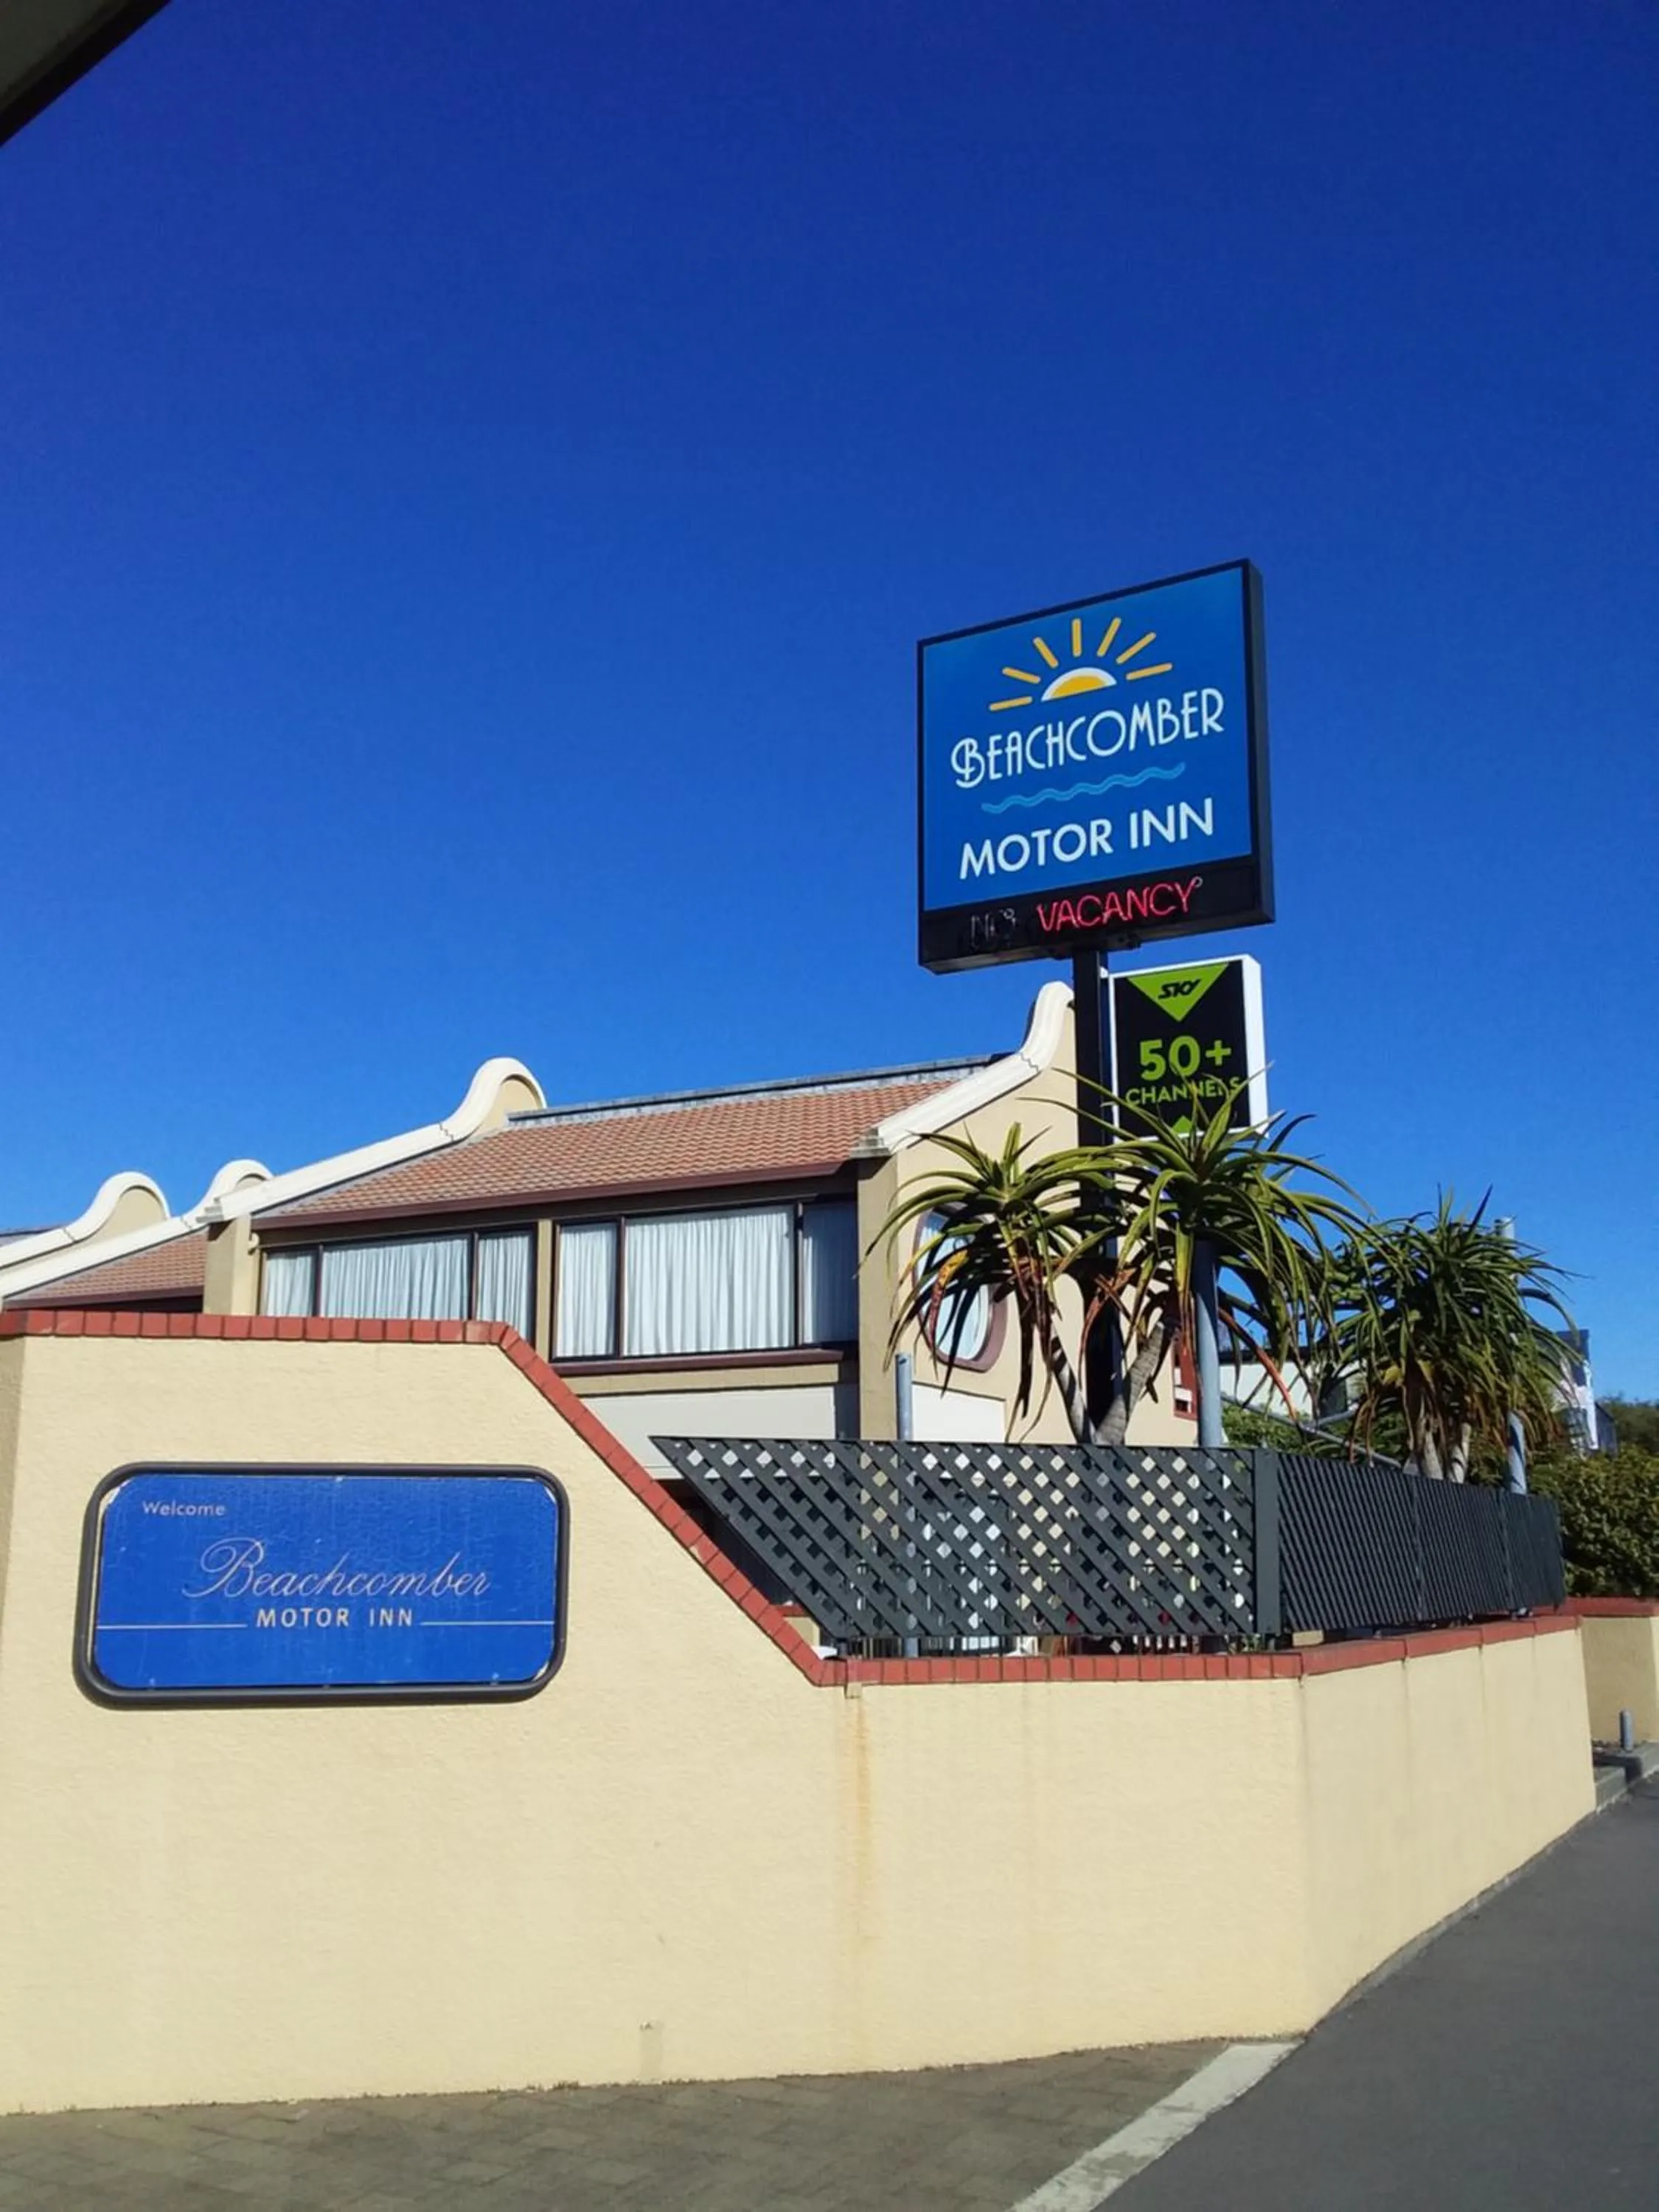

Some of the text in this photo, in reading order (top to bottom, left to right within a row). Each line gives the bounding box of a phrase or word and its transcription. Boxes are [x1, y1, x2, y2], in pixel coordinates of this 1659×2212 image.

[950, 686, 1225, 788] BEACHCOMBER
[959, 797, 1214, 880] MOTOR INN
[1036, 876, 1203, 932] VACANCY
[1157, 978, 1202, 1000] SKY
[1139, 1034, 1231, 1081] 50+
[142, 1500, 226, 1517] Welcome
[182, 1537, 491, 1599] Beachcomber
[256, 1607, 414, 1628] MOTOR INN
